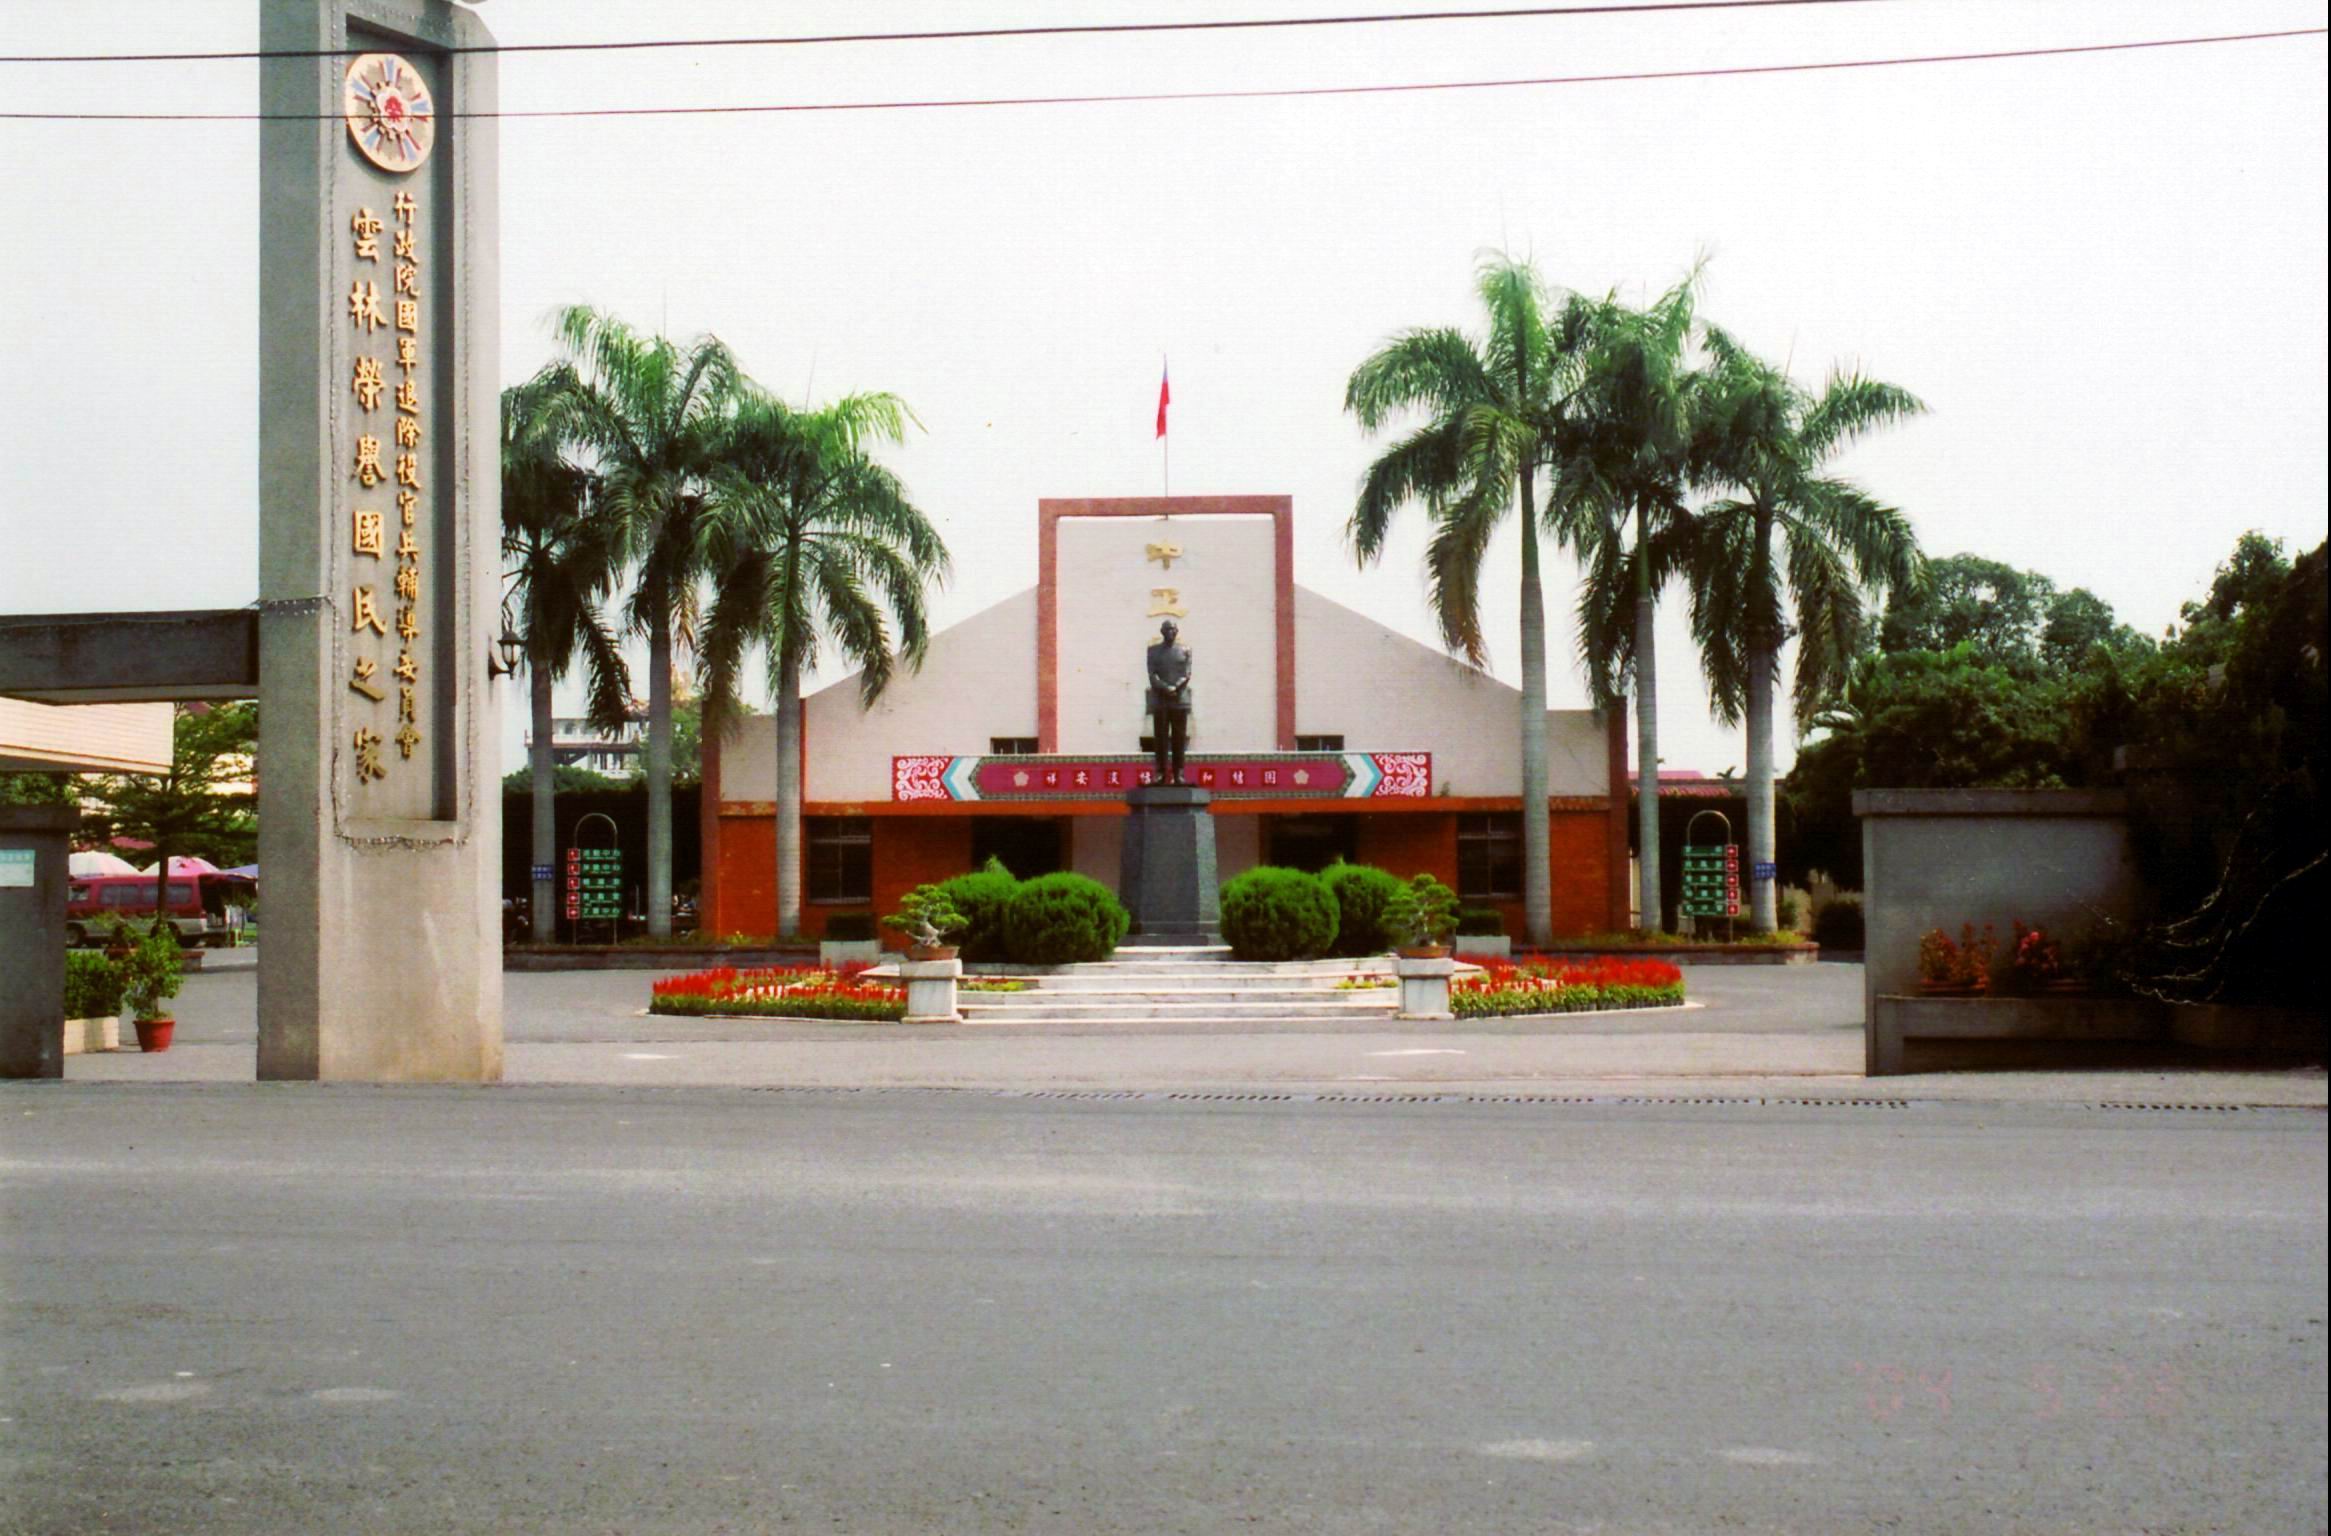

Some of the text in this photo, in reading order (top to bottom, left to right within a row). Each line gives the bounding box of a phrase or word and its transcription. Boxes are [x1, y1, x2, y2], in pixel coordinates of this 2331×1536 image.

[348, 207, 388, 785] 雲林榮譽國民之家
[1144, 538, 1190, 646] 中正
